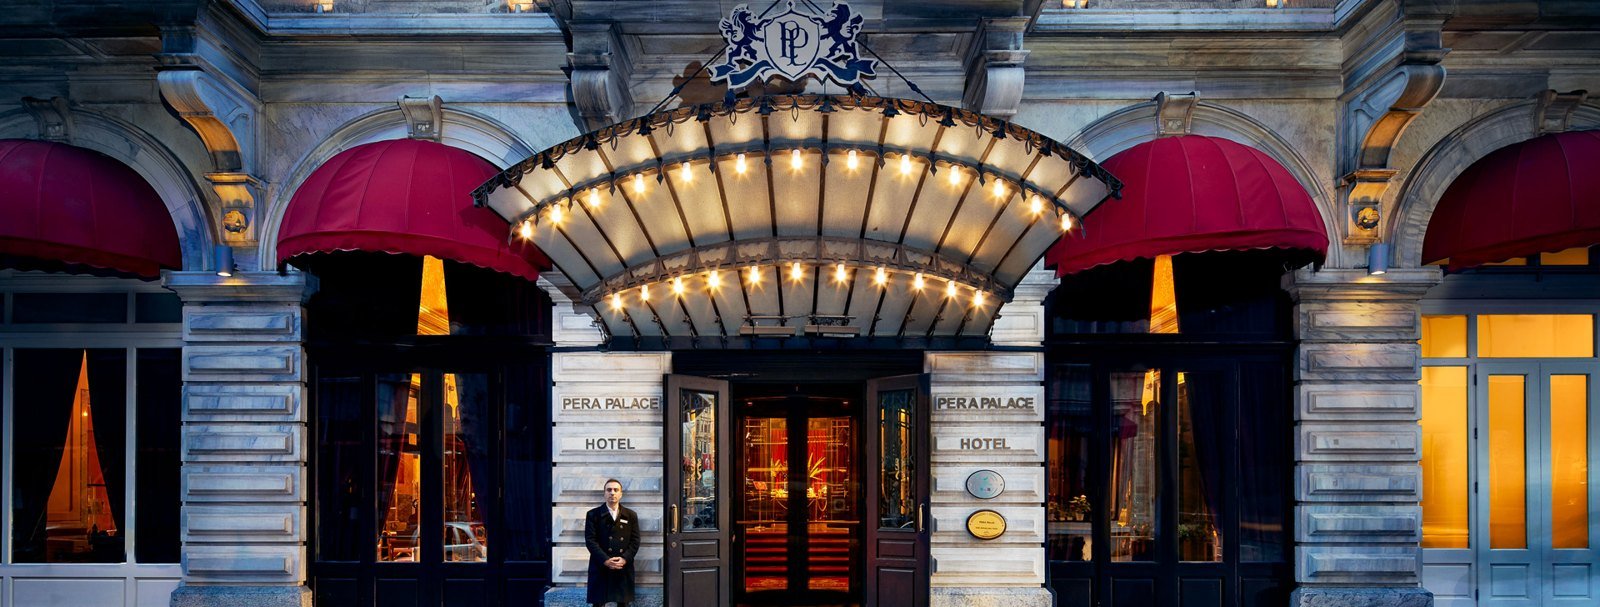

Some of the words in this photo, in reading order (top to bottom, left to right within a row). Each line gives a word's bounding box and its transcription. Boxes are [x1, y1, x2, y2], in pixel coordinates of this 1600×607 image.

[562, 397, 601, 410] PERA
[605, 397, 659, 410] PALACE
[937, 397, 979, 409] PERA
[980, 397, 1034, 409] PALACE
[585, 438, 636, 450] HOTEL
[960, 438, 1011, 450] HOTEL
